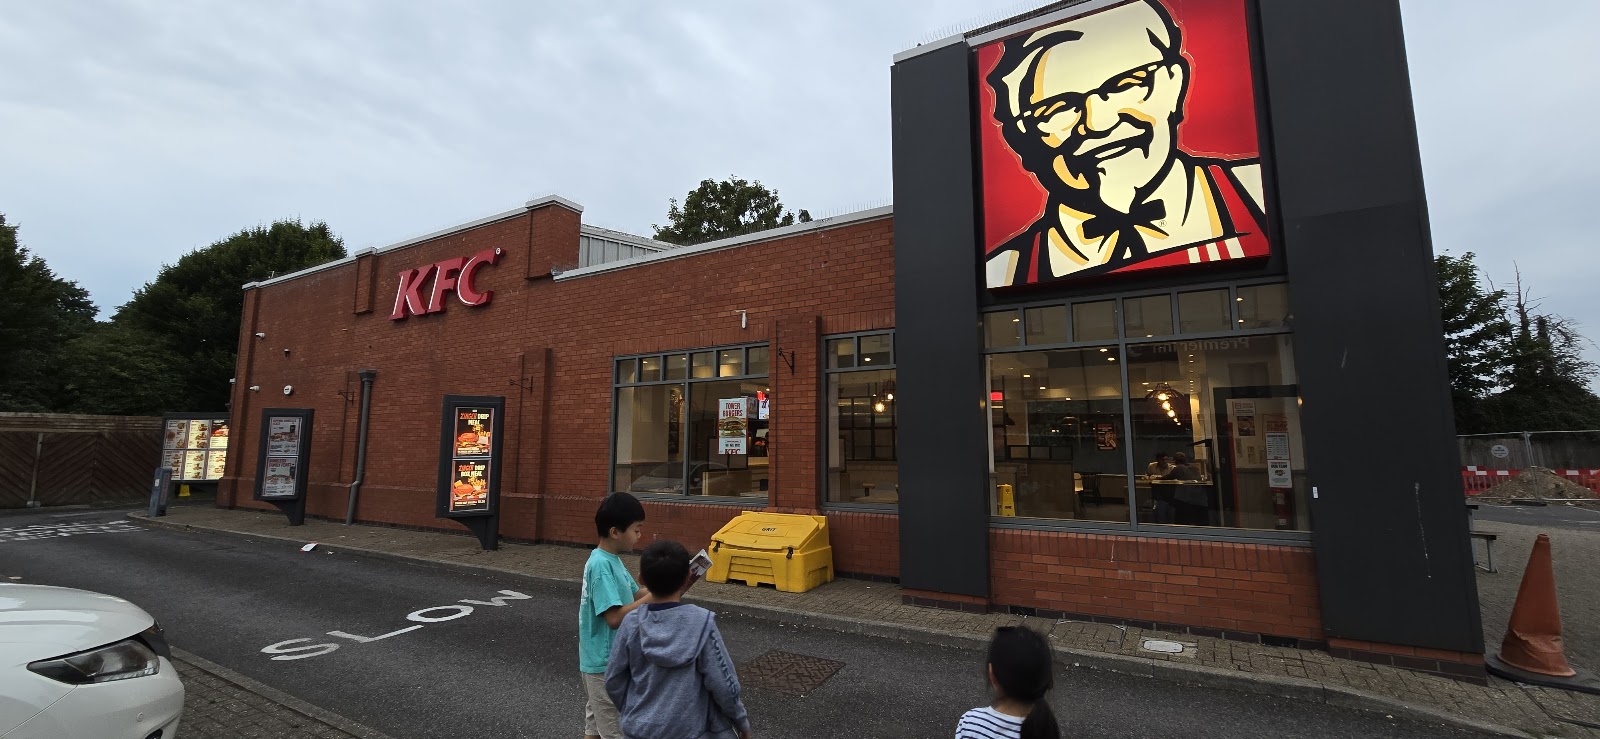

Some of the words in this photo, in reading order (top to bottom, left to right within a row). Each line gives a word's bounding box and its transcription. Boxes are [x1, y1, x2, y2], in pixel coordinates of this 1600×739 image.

[389, 248, 496, 320] KFC
[725, 402, 741, 410] TOWER
[260, 589, 533, 661] SLOW
